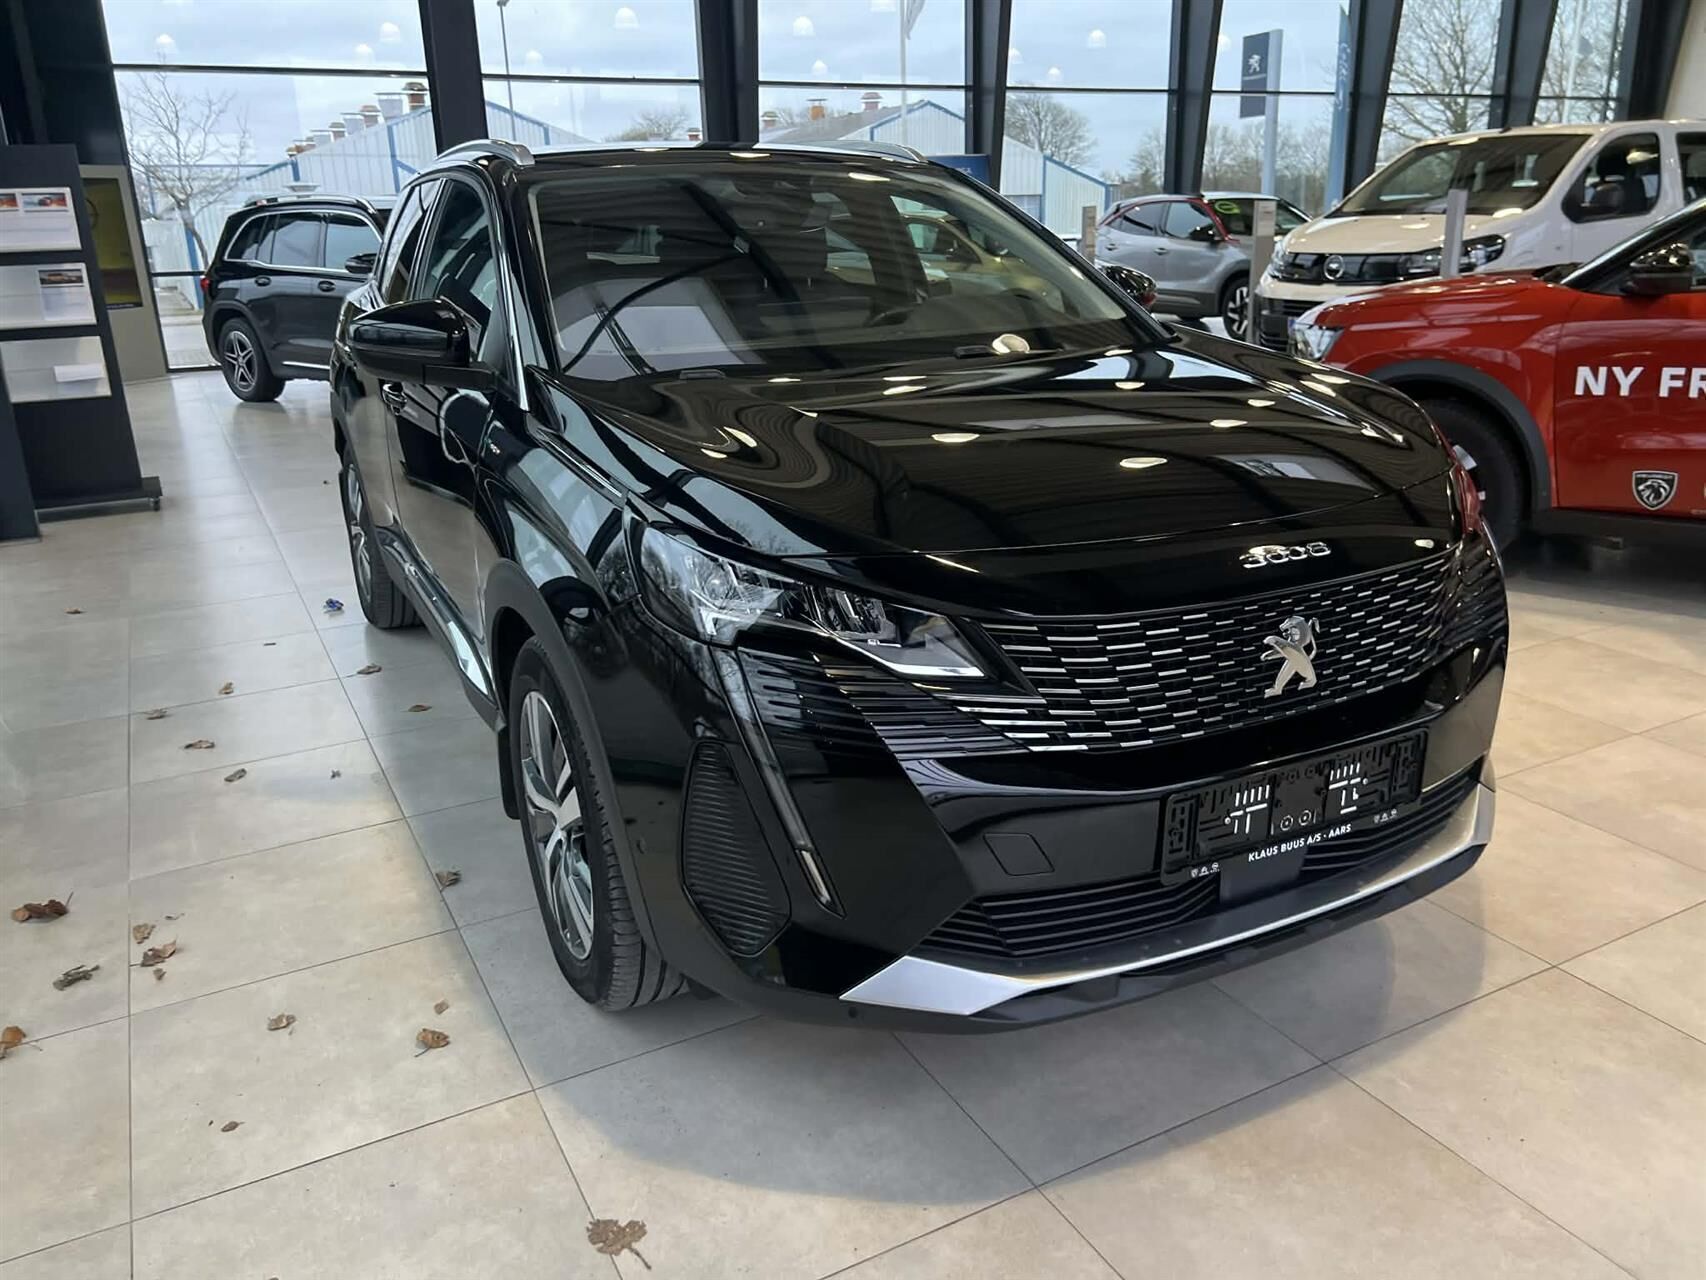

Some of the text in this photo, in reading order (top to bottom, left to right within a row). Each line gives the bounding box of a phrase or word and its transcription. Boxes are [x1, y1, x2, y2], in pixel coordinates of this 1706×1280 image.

[1574, 366, 1644, 396] NY
[1248, 823, 1352, 862] KLAUS BUUS A/S AARS
